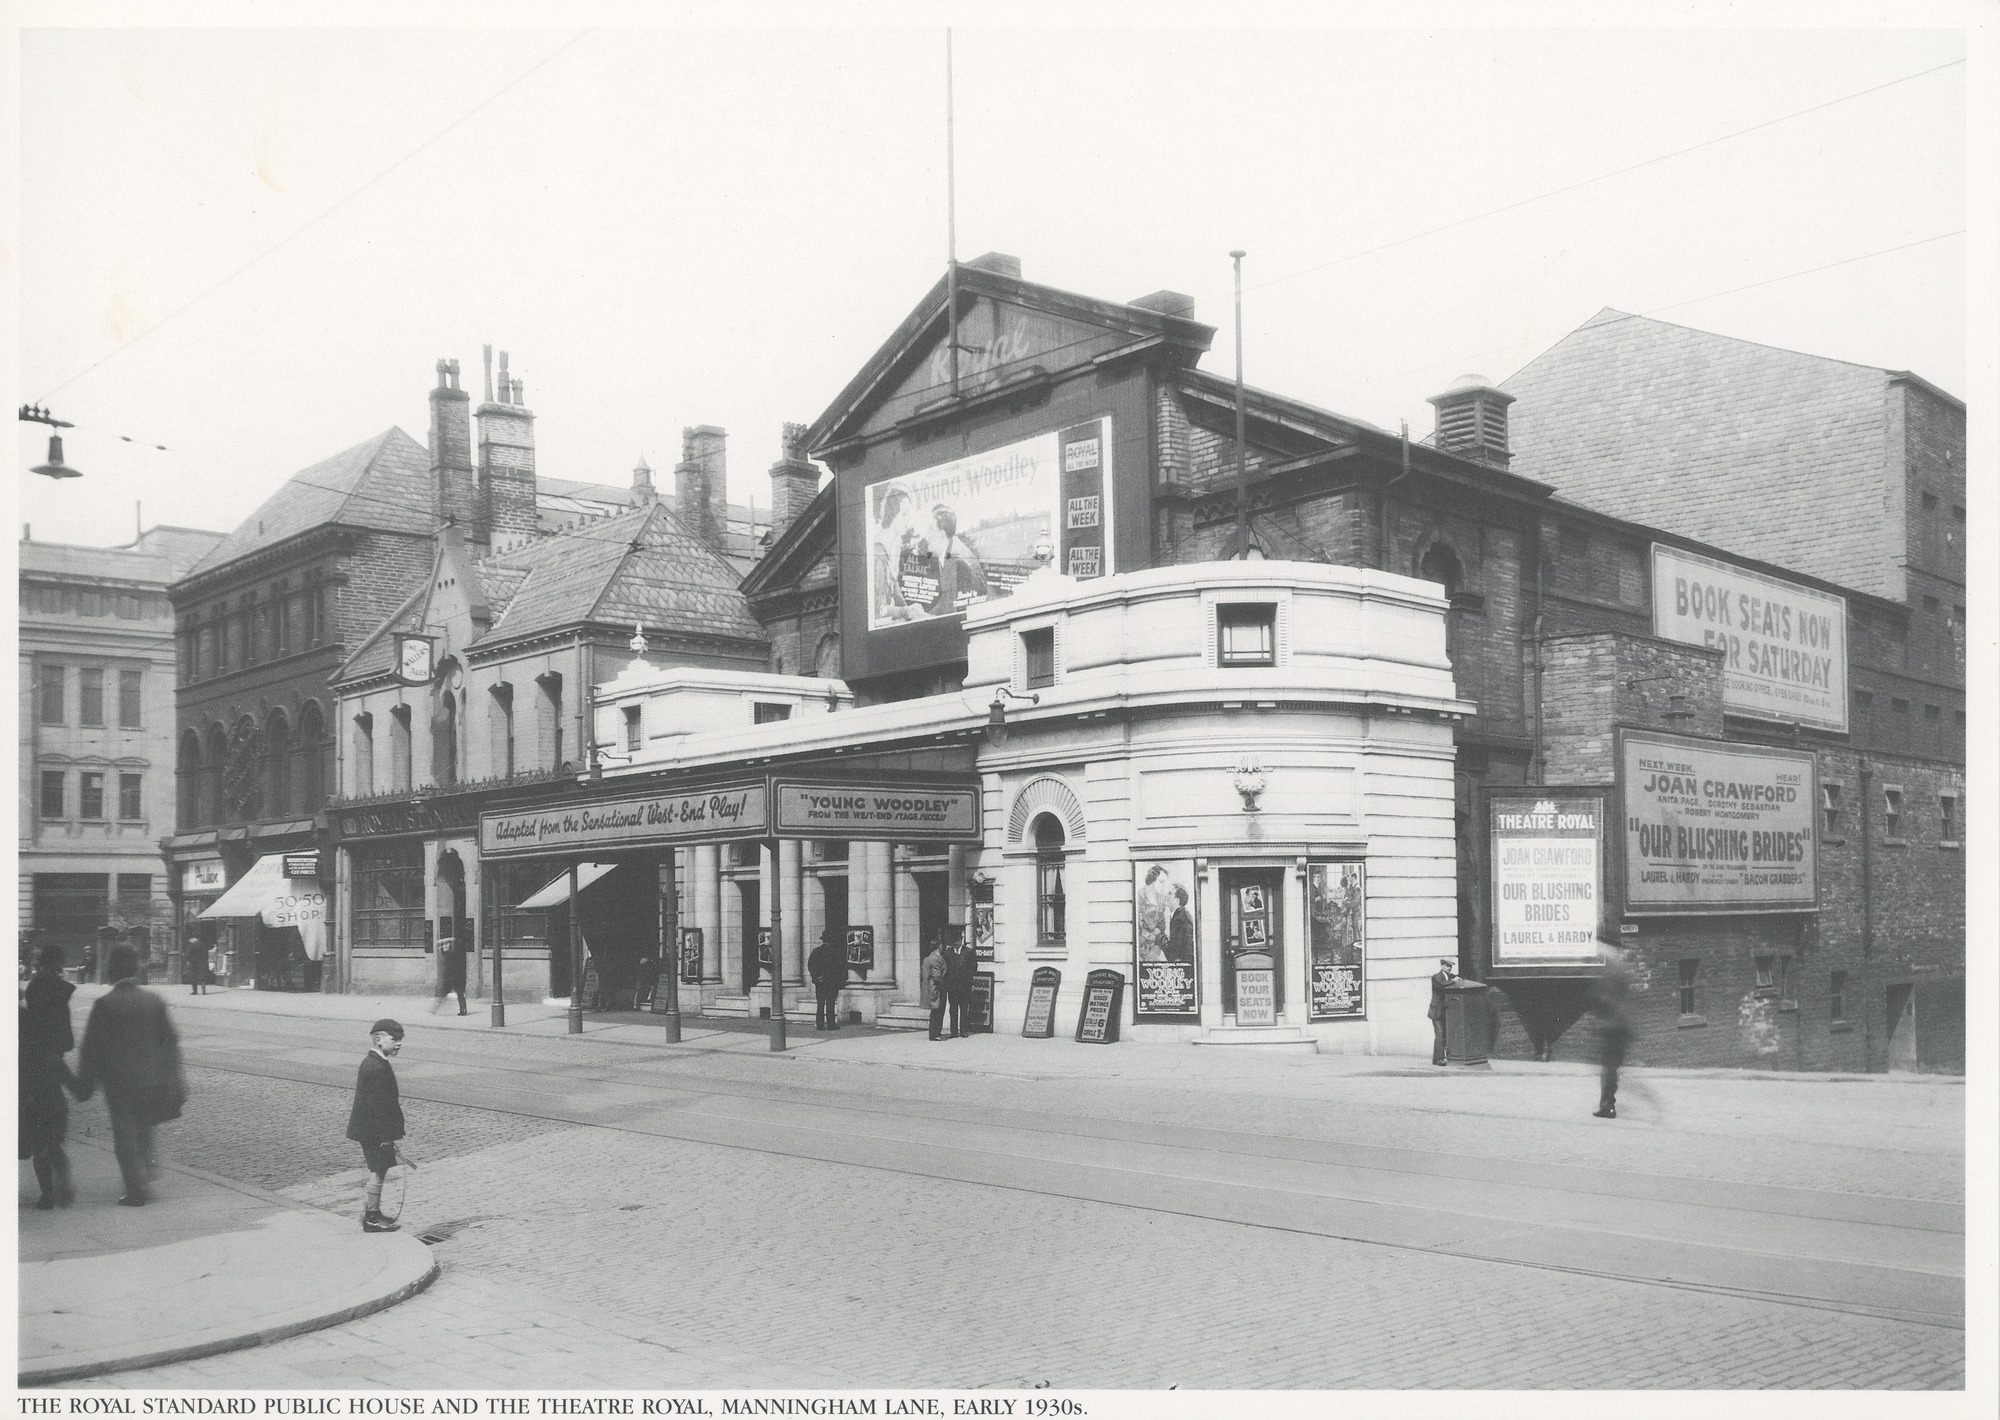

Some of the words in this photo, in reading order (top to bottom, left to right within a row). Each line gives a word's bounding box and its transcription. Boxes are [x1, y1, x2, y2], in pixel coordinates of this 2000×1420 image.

[1067, 444, 1097, 460] ROYAL
[912, 476, 961, 510] Young
[966, 454, 1039, 498] Woodley
[1070, 500, 1082, 512] ALL
[1084, 498, 1098, 510] THE
[1072, 512, 1096, 526] WEEK
[1070, 548, 1084, 560] ALL
[1085, 548, 1099, 560] THE
[1072, 562, 1097, 575] WEEK
[1675, 577, 1732, 627] BOOK
[1738, 594, 1792, 642] SEATS
[1799, 610, 1832, 651] NOW
[1704, 629, 1741, 669] FOR
[1748, 640, 1832, 689] SATURDAY
[1639, 758, 1664, 770] NEXT
[1644, 774, 1698, 796] JOAN
[1702, 780, 1797, 803] CRAWFORD
[800, 794, 866, 810] "YOUNG
[873, 798, 958, 812] WOODLEY"
[1657, 796, 1679, 804] ANITA
[1708, 800, 1737, 810] DOROTHY
[1741, 802, 1780, 812] SEBASTIAN
[496, 819, 536, 842] Adapted
[538, 818, 560, 842] from
[563, 815, 578, 832] the
[580, 805, 644, 832] Sensational
[647, 800, 706, 825] West-End
[710, 793, 747, 822] Play!
[808, 810, 832, 818] FROM
[834, 811, 849, 819] THE
[853, 812, 892, 820] WEST-END
[894, 812, 918, 821] STAGE
[919, 813, 947, 822] SUCCESS
[1684, 808, 1711, 817] ROBERT
[1714, 812, 1760, 820] MONTGOMERY
[1498, 814, 1554, 830] THEATRE
[1558, 814, 1596, 830] ROYAL
[1629, 818, 1672, 858] "OUR
[1677, 826, 1749, 860] BLUSHING
[1752, 828, 1810, 862] BRIDES"
[1503, 848, 1530, 866] JOAN
[1533, 848, 1592, 866] CRAWFORD
[1641, 870, 1668, 884] LAUREL
[1676, 872, 1700, 884] HARDY
[1739, 872, 1768, 885] "BACON
[1770, 872, 1806, 885] GRABBERS"
[1503, 882, 1527, 900] OUR
[1532, 882, 1592, 900] BLUSHING
[1524, 904, 1570, 922] BRIDES
[1504, 932, 1544, 944] LAUREL
[1548, 932, 1554, 942] &
[1558, 930, 1593, 944] HARDY
[1146, 968, 1185, 980] YOUNG
[1241, 973, 1268, 982] BOOK
[1318, 970, 1354, 982] YOUNG
[1140, 978, 1194, 990] WOODLEY
[1240, 986, 1270, 994] YOUR
[1312, 980, 1362, 992] WOODLEY
[1240, 998, 1272, 1006] SEATS
[1243, 1010, 1268, 1019] NOW
